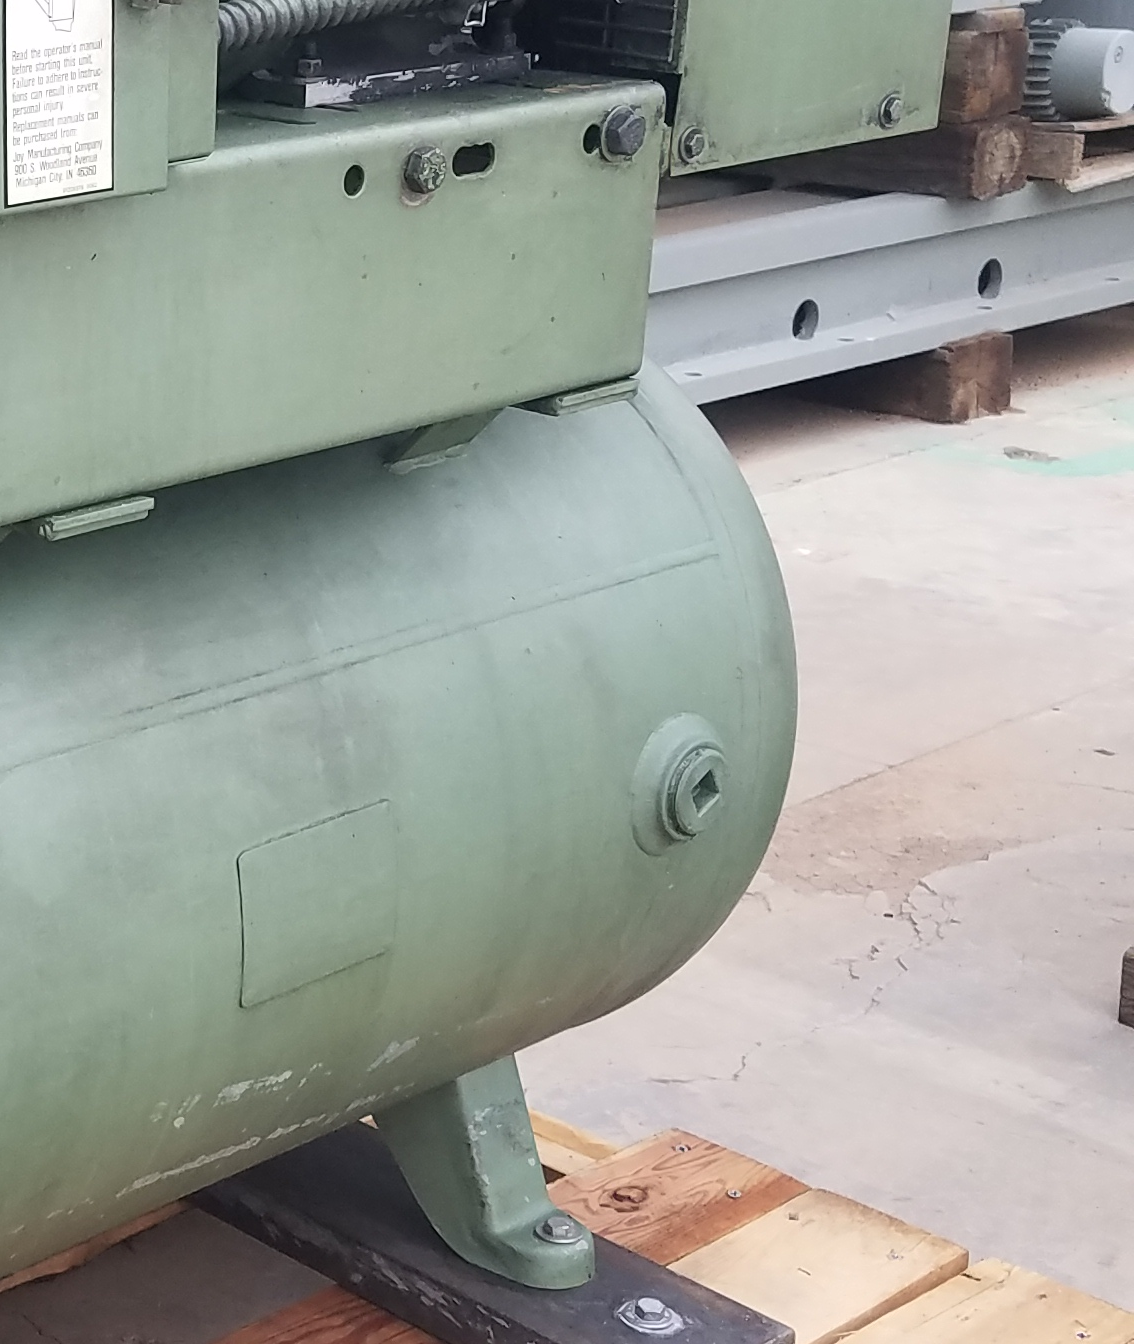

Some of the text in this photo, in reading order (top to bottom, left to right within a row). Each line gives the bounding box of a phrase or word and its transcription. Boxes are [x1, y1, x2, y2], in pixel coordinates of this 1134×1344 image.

[12, 38, 102, 61] Read the operator's manual
[12, 63, 32, 75] before
[35, 59, 60, 72] starting
[64, 57, 75, 67] this
[12, 77, 35, 89] Failure
[38, 76, 44, 85] to
[46, 73, 68, 84] adhere
[70, 71, 76, 80] to
[12, 82, 98, 103] tions can result in severe
[13, 111, 99, 133] Replacement manuals can
[13, 135, 20, 146] be
[23, 129, 57, 146] purchased
[13, 140, 102, 163] Joy Manufacturing Company
[14, 163, 27, 175] 900
[39, 158, 71, 171] Woodland
[75, 154, 97, 165] Avenue
[16, 176, 46, 188] Michigan
[66, 169, 73, 179] IN
